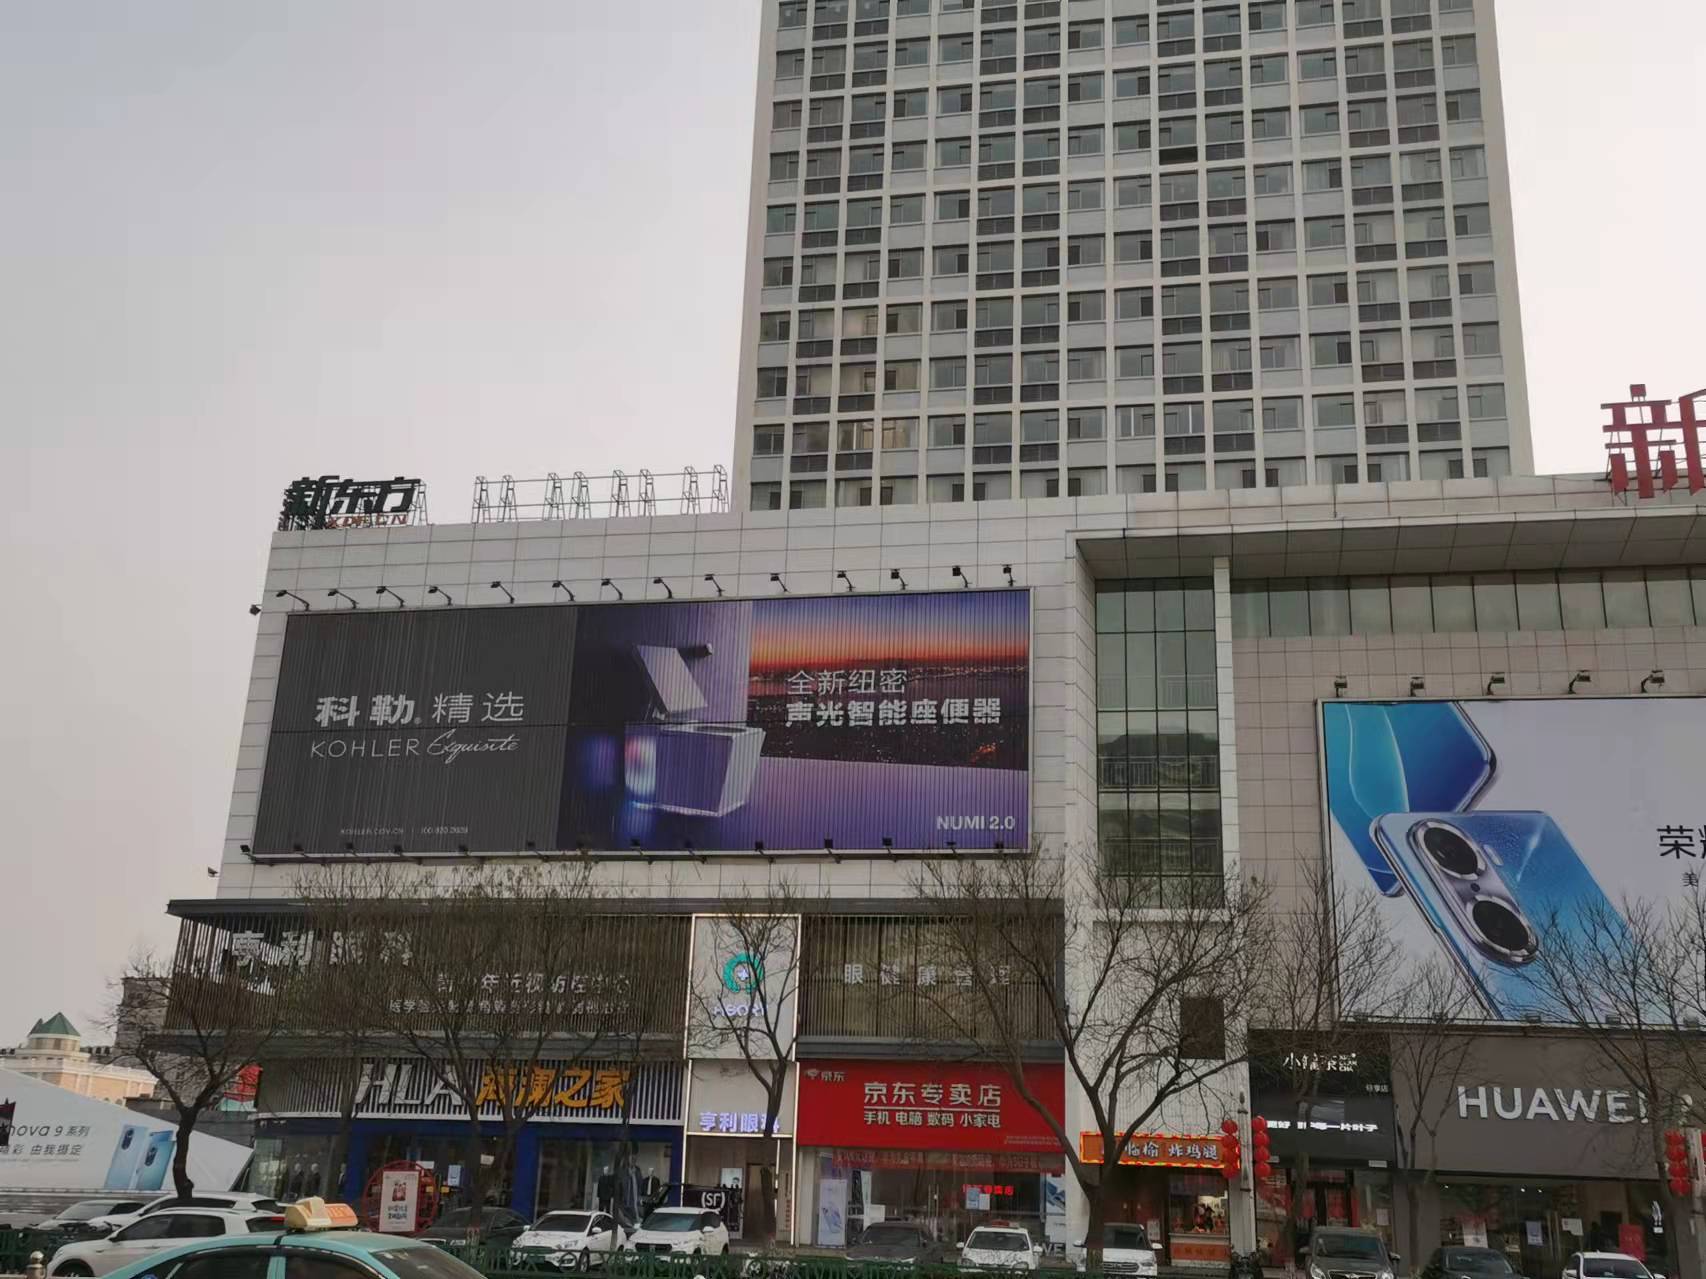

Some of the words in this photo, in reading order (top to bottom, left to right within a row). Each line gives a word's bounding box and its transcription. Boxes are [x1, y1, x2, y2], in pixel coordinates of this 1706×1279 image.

[289, 475, 421, 520] 新东方
[786, 668, 909, 696] 全新纽密
[314, 695, 415, 727] 科勒
[431, 691, 524, 724] 精选
[785, 698, 1002, 728] 声光智能座便器
[310, 738, 420, 758] KOHLER
[426, 728, 521, 764] Exquisite
[936, 816, 985, 830] NUMI
[988, 815, 1016, 830] 2.0
[844, 963, 1010, 987] 眼健康管理
[353, 1063, 464, 1106] HLA
[475, 1066, 629, 1107] 海澜之家
[863, 1081, 1002, 1107] 京东专卖店
[1457, 1085, 1648, 1124] HUAWEI
[11, 1125, 51, 1137] nova
[54, 1125, 64, 1137] 9
[65, 1125, 91, 1137] 系列
[863, 1111, 891, 1125] 手机
[895, 1112, 923, 1127] 电脑
[927, 1113, 954, 1128] 数码
[960, 1113, 1001, 1129] 小家电
